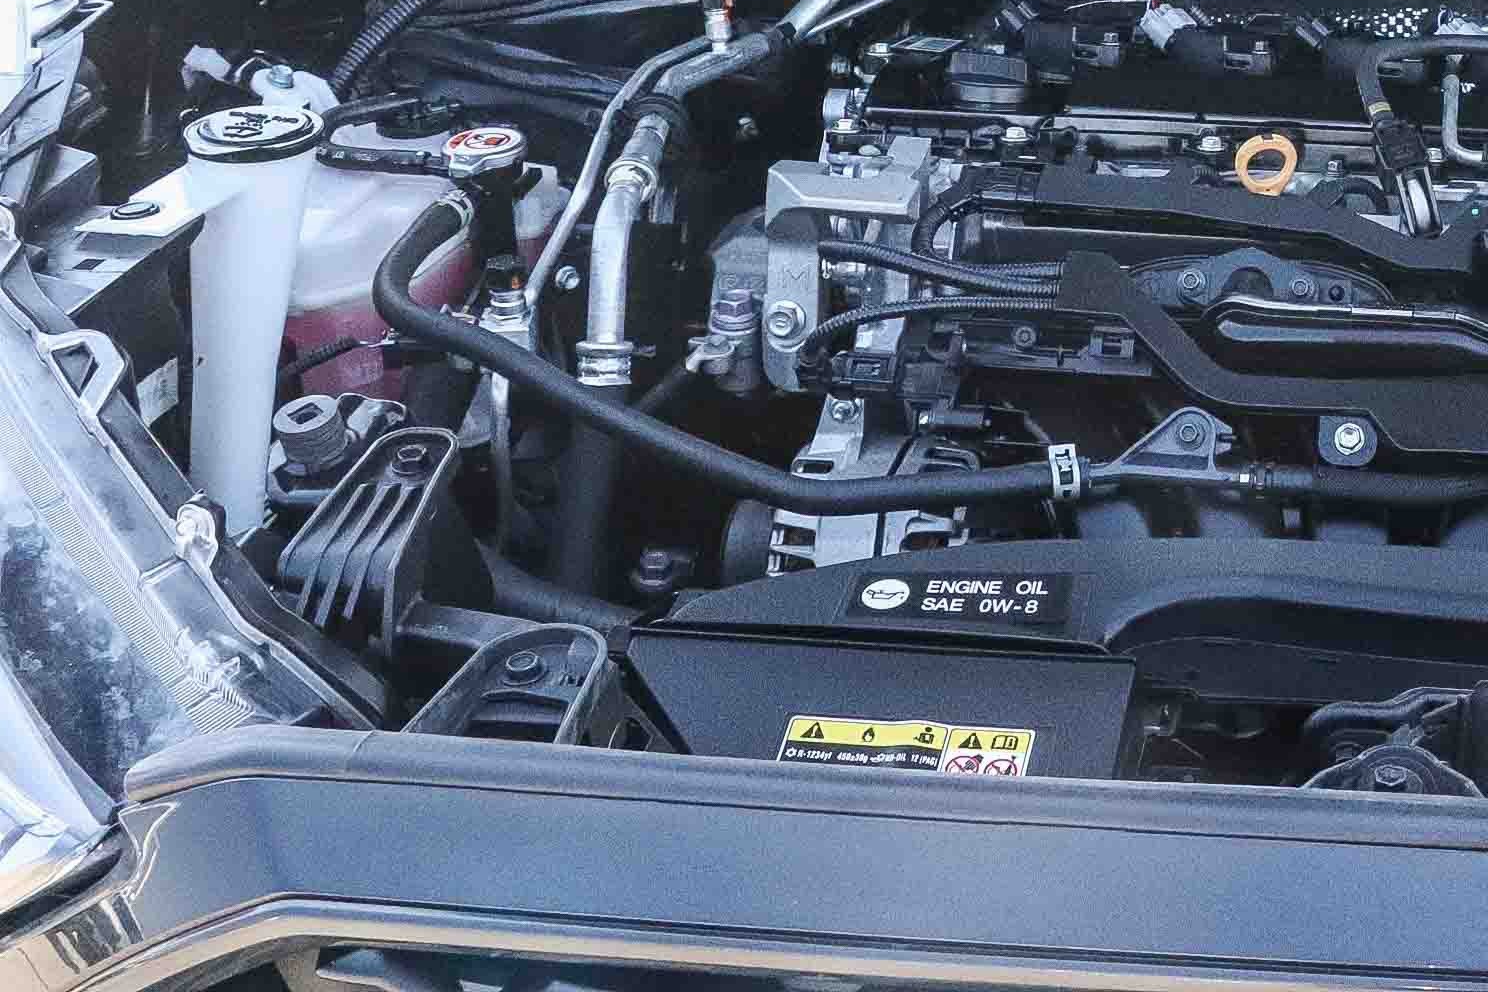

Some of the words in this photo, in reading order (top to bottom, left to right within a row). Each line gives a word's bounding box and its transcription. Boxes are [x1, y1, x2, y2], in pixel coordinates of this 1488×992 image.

[926, 580, 1003, 594] ENGINE
[1015, 580, 1049, 595] OIL
[920, 597, 965, 612] SAE
[979, 598, 1039, 614] 0W-8
